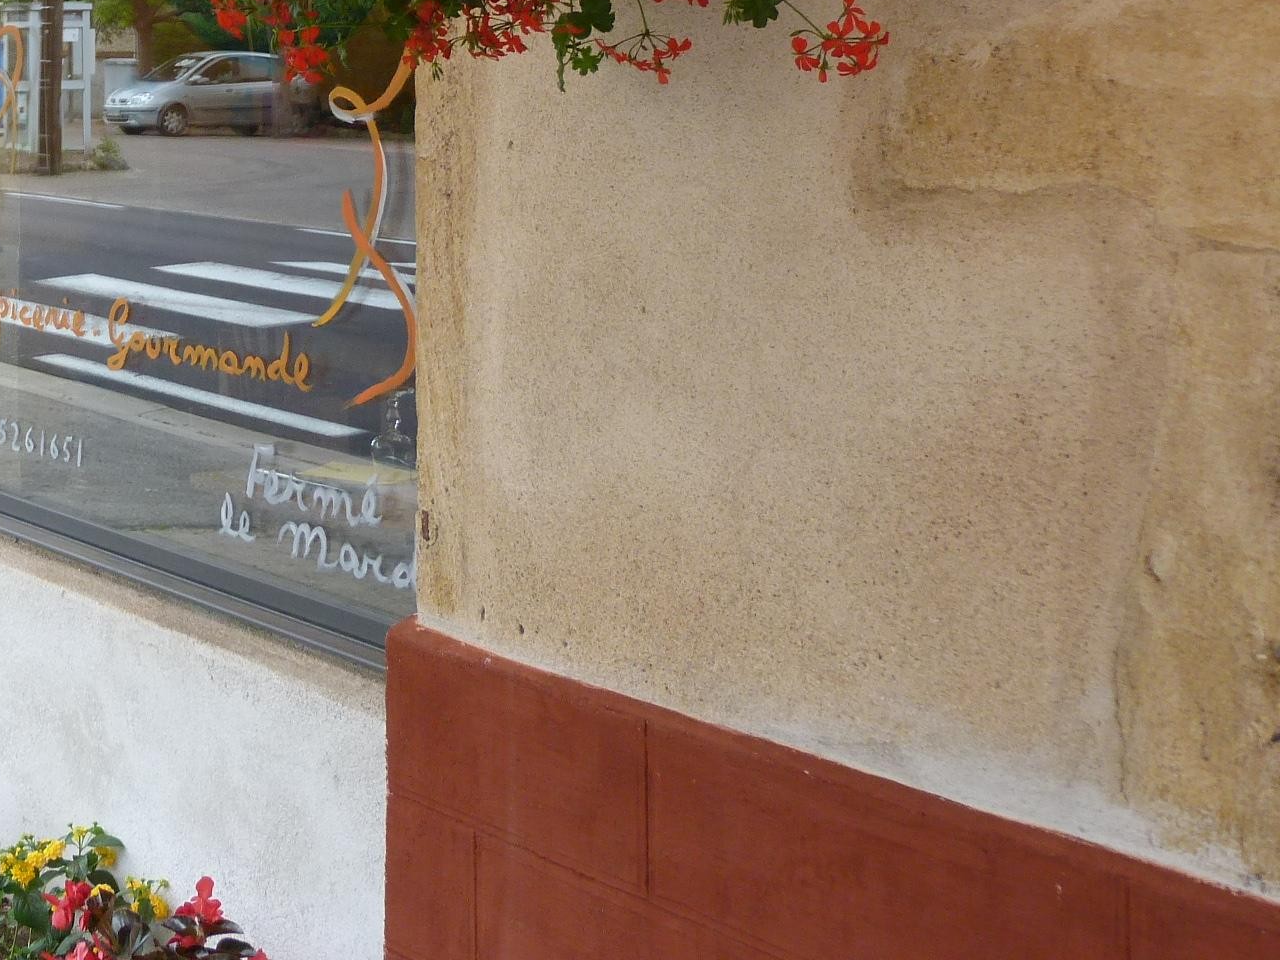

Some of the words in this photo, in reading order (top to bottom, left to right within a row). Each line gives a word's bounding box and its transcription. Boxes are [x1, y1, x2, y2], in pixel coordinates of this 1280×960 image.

[107, 296, 312, 392] Gourmande
[246, 443, 382, 528] Fermé
[220, 492, 255, 541] le
[278, 520, 416, 589] Mard
